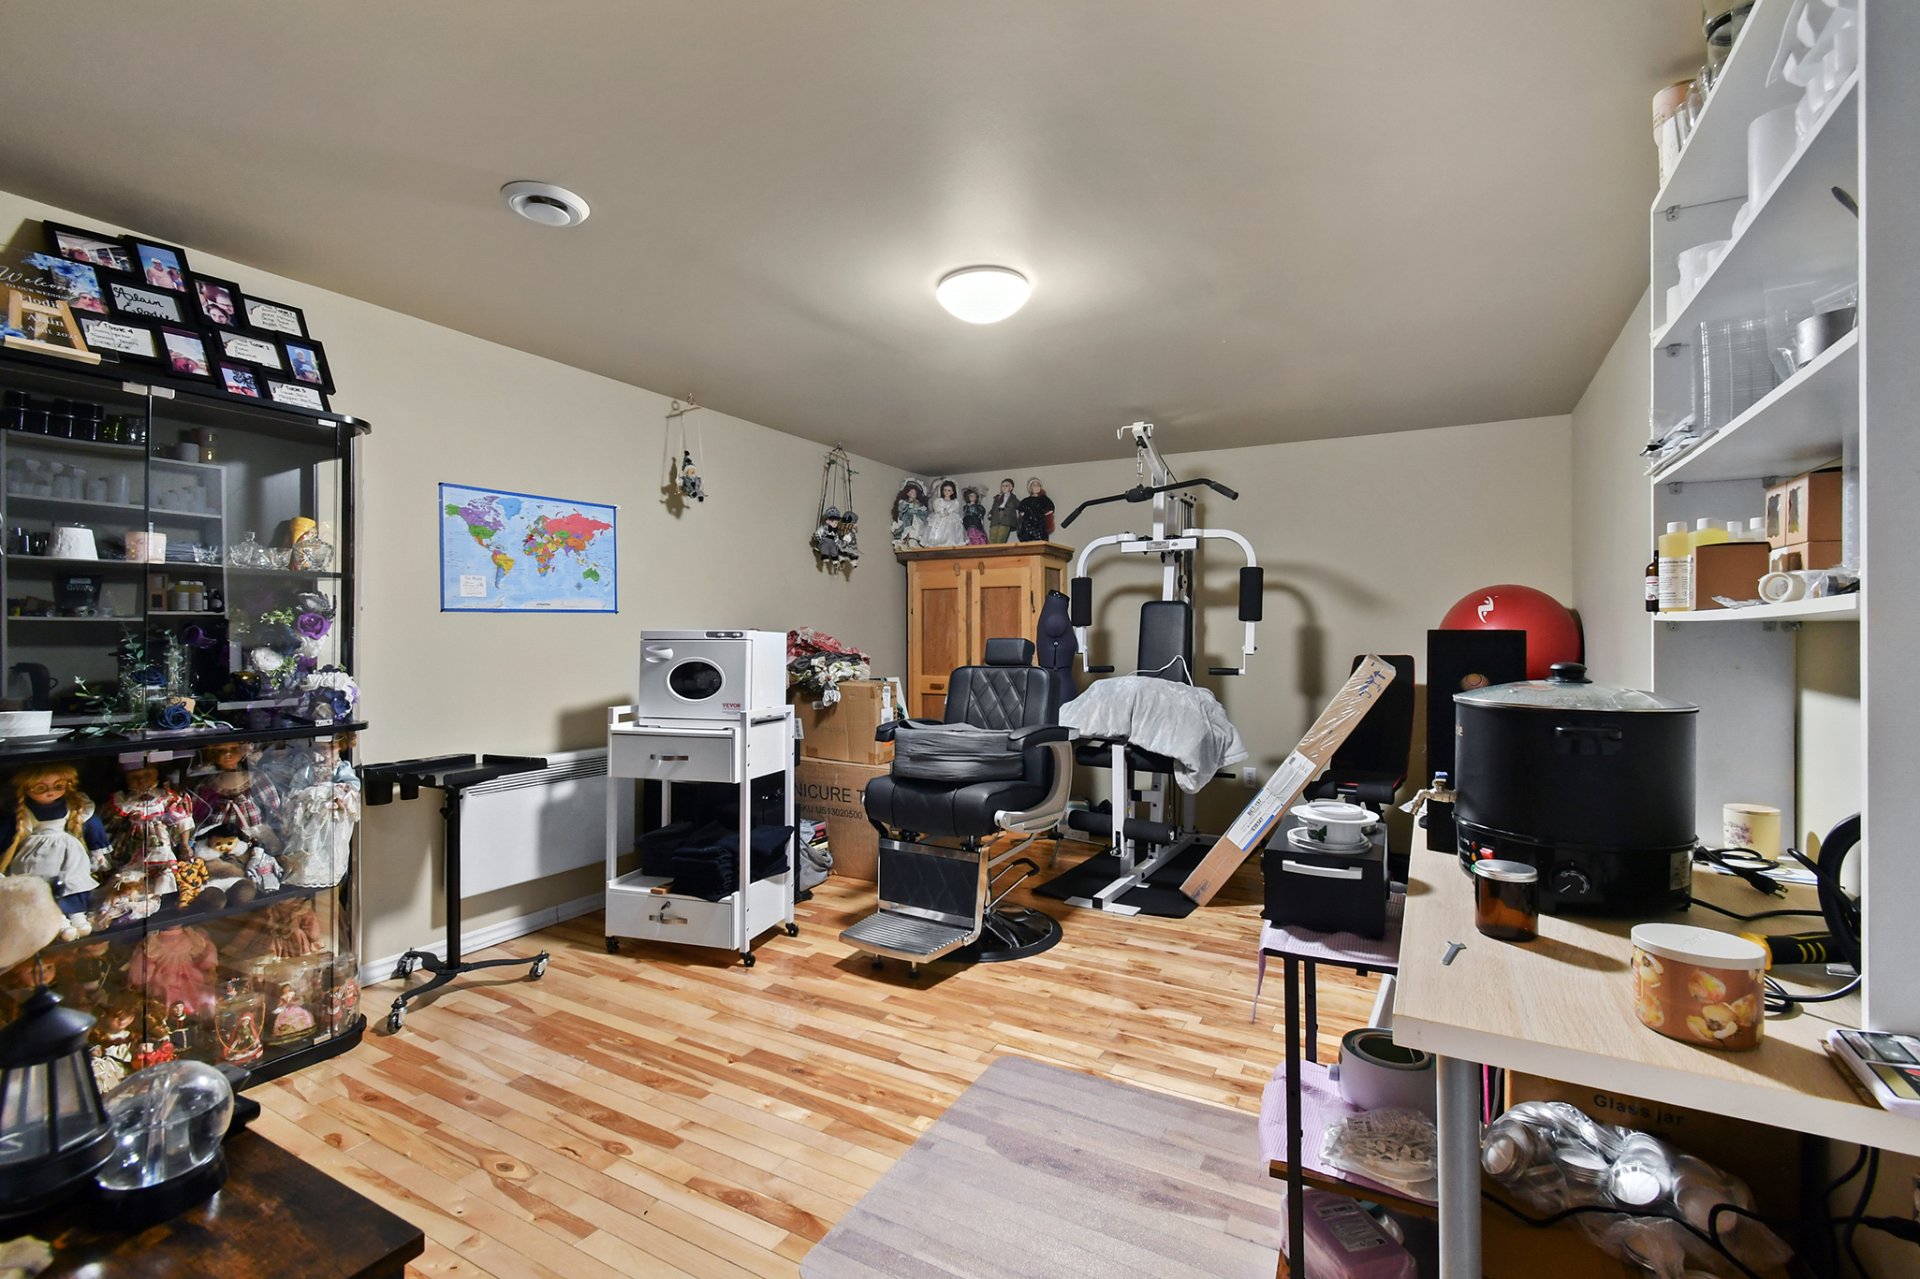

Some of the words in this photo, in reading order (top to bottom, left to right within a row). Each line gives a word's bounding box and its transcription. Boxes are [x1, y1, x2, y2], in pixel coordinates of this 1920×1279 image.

[113, 286, 164, 308] Alain
[816, 806, 863, 819] US13020500
[1593, 1094, 1650, 1118] Glass
